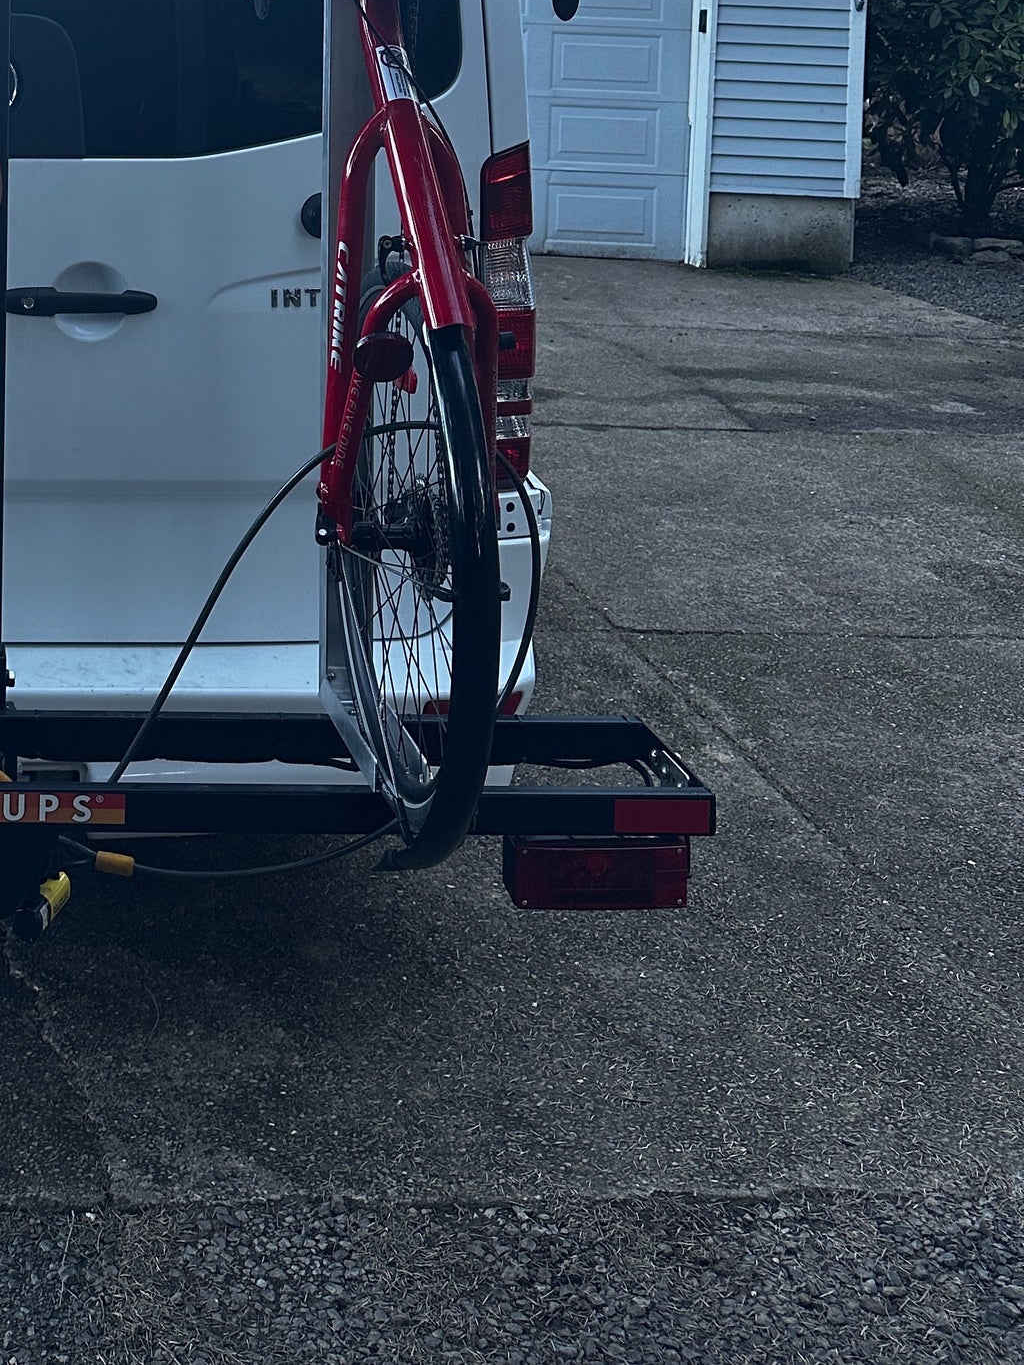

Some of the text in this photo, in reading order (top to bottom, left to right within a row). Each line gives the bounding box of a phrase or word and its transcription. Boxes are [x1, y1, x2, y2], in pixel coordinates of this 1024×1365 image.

[330, 240, 350, 374] CATRIKE
[343, 399, 357, 434] FIVE
[336, 434, 349, 470] NINE
